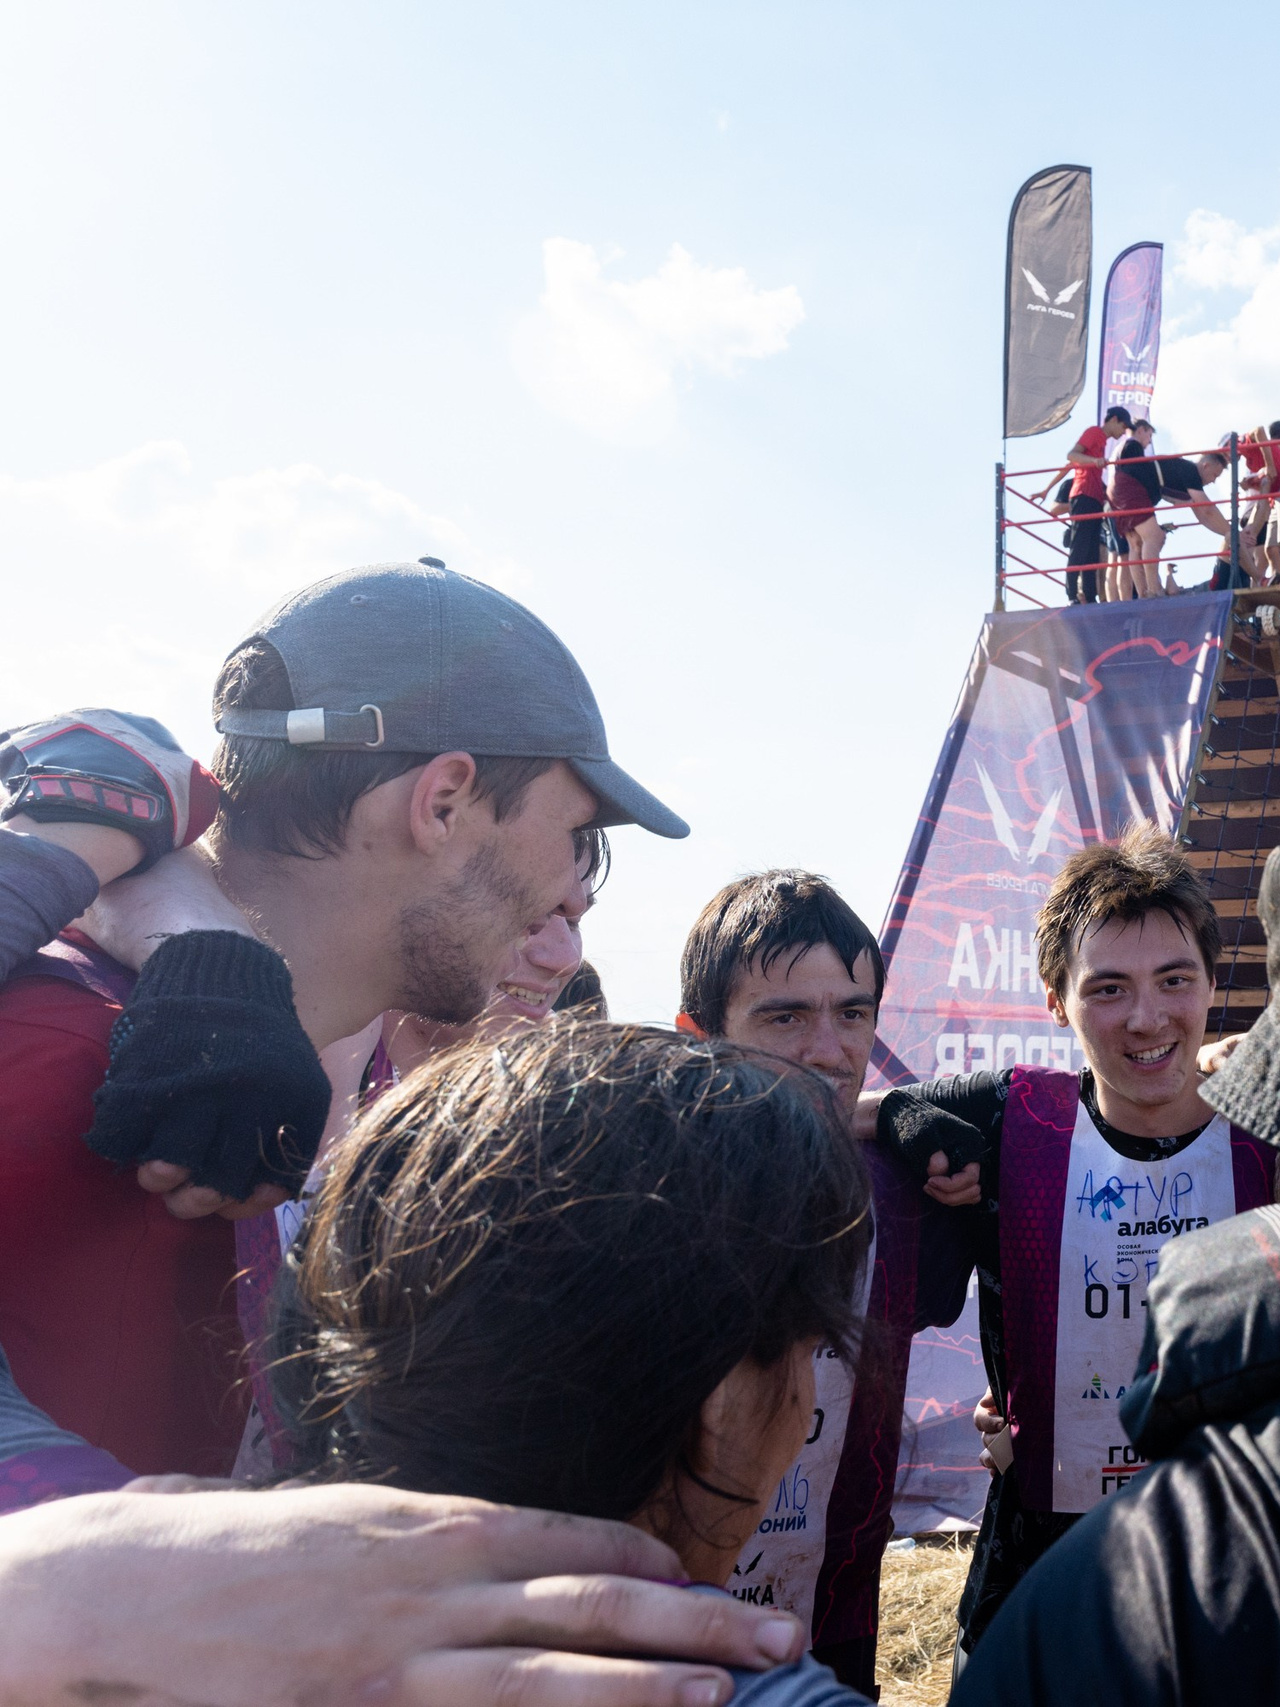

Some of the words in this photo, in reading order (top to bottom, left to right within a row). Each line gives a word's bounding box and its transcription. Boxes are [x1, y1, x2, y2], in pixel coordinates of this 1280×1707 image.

[1048, 307, 1075, 319] ГЕРОЕВ
[1108, 390, 1152, 406] ГЕРОЕ
[1117, 1215, 1210, 1238] алабуга
[1085, 1283, 1149, 1319] 01-
